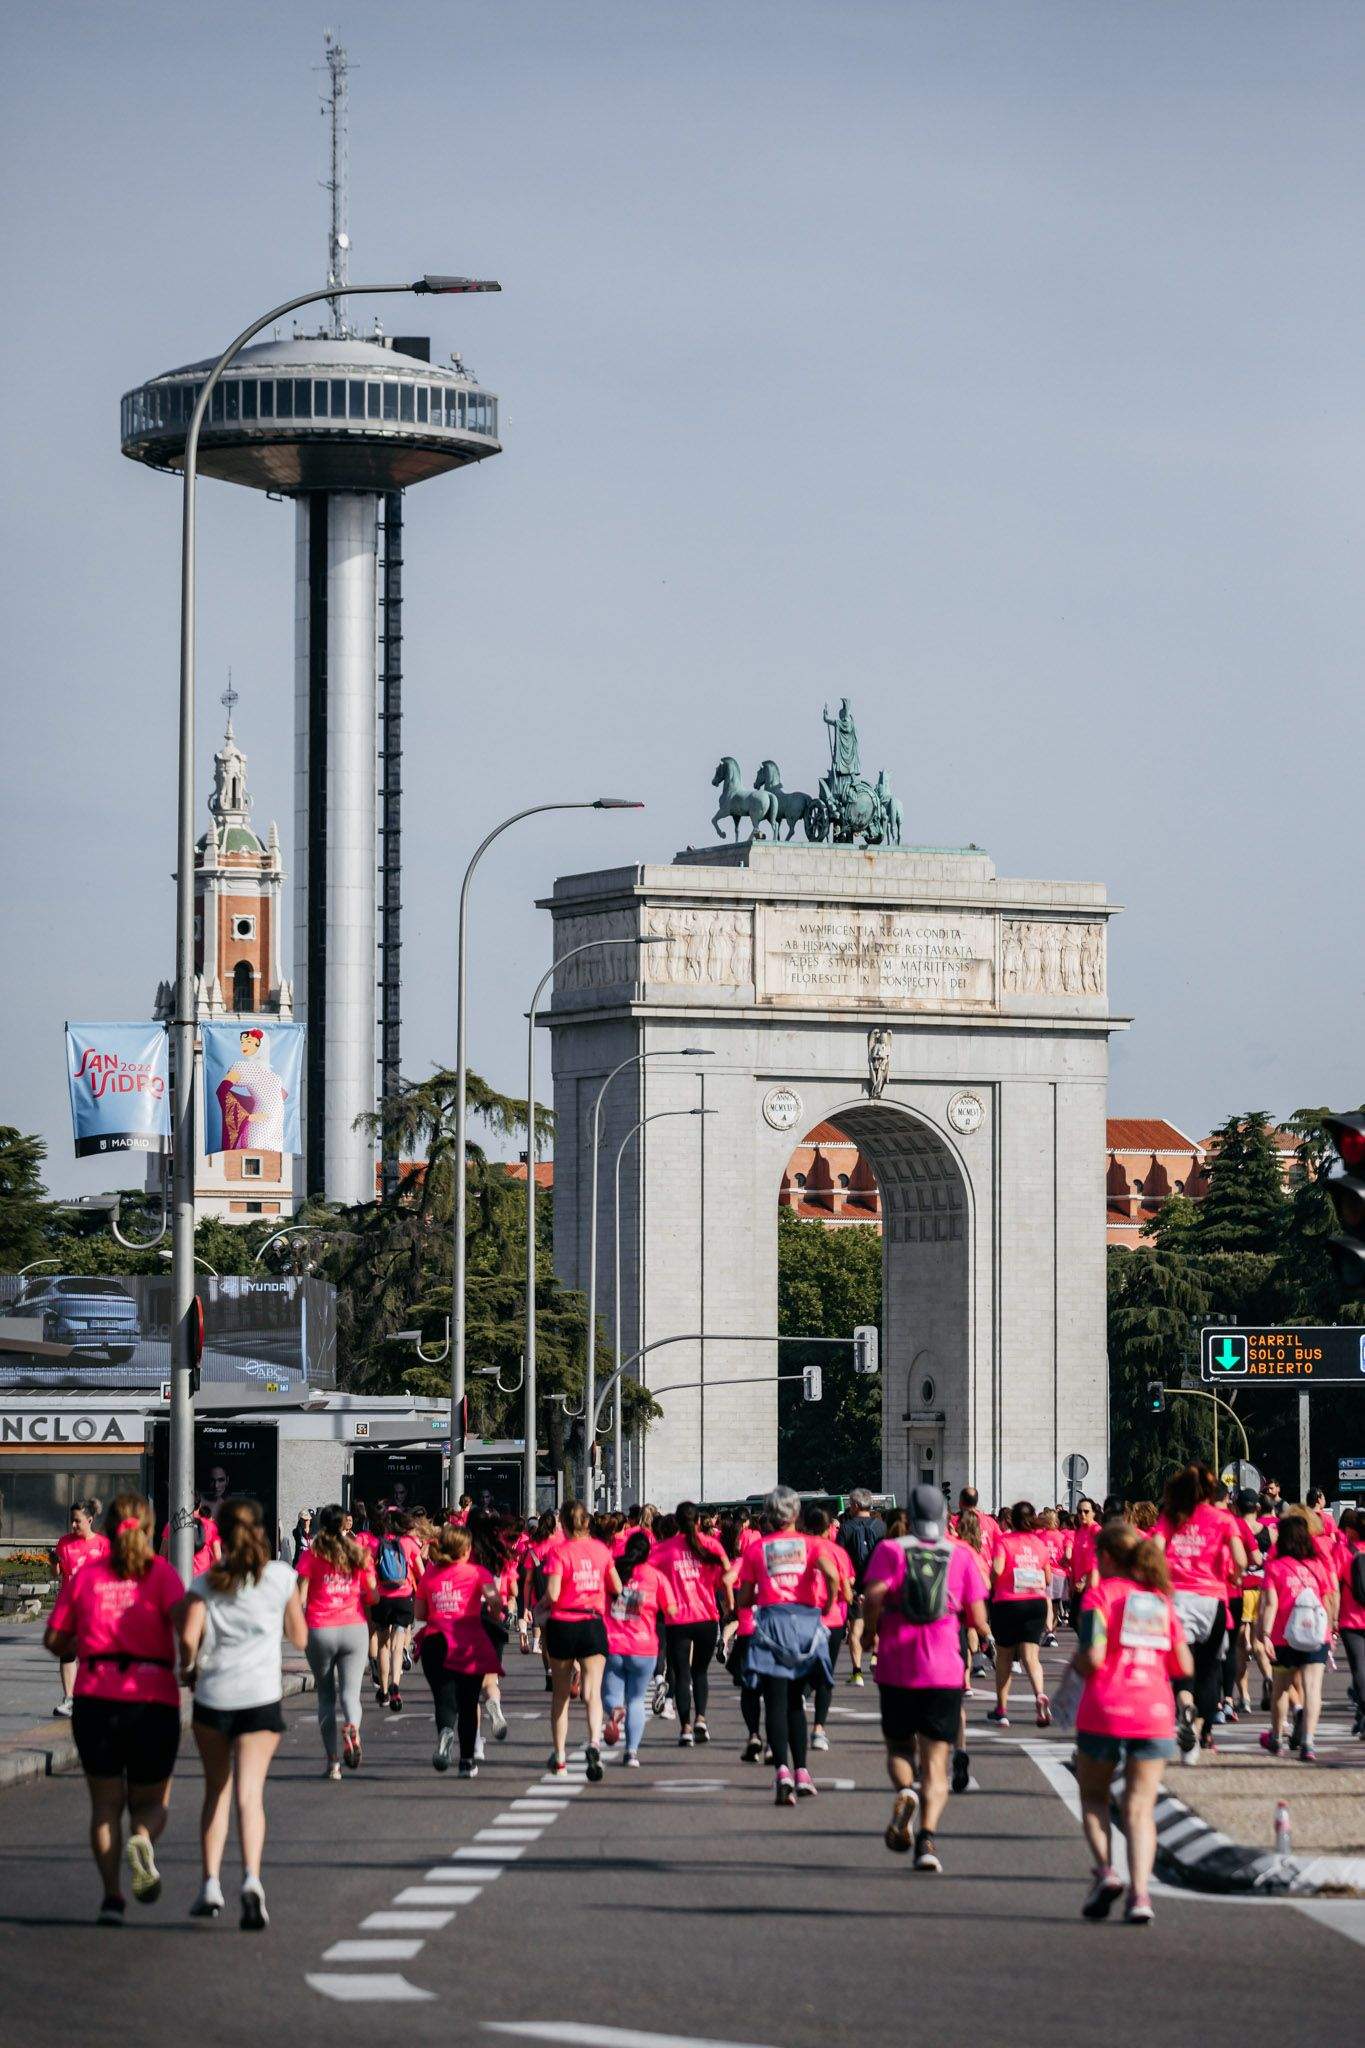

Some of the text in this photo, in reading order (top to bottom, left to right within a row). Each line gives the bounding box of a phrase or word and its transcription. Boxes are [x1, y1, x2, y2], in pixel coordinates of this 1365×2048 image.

[879, 927, 911, 938] REGIA
[915, 928, 962, 940] CONDITA
[785, 941, 798, 950] AB
[791, 973, 848, 984] FLORESCIT
[950, 978, 966, 988] DEI
[74, 1048, 118, 1078] SAN
[111, 1138, 151, 1148] MADRID
[1249, 1335, 1303, 1346] CARRIL
[1249, 1349, 1322, 1360] SOLO BUS
[1249, 1363, 1313, 1374] ABIERTO
[2, 1416, 125, 1442] NCLOA
